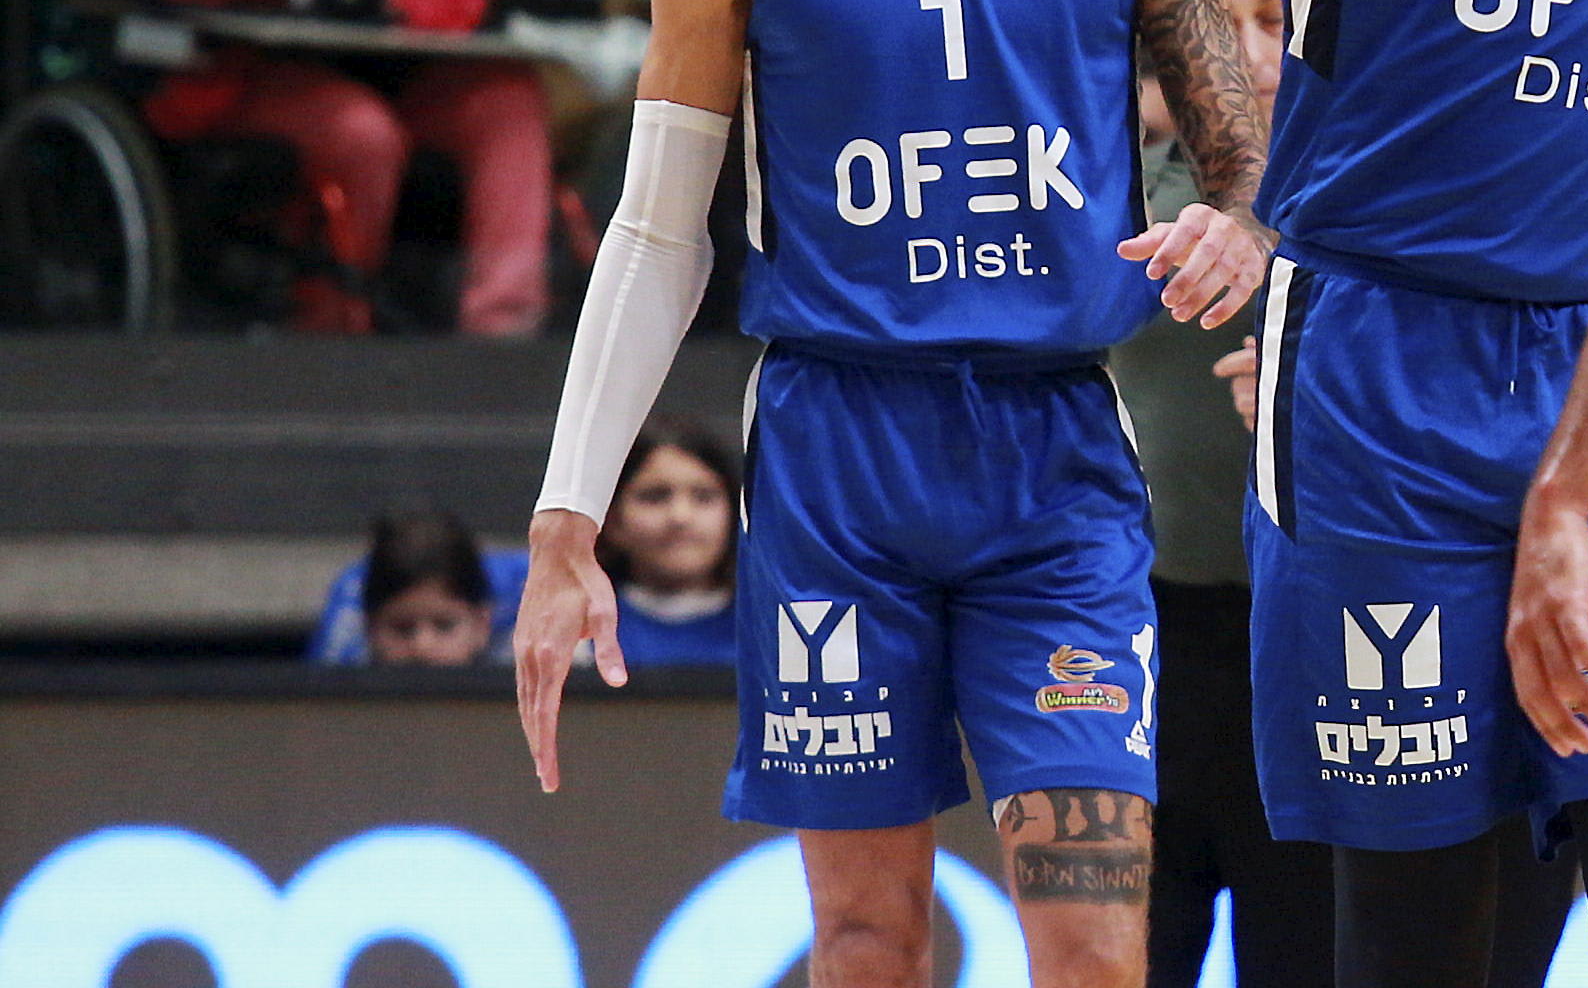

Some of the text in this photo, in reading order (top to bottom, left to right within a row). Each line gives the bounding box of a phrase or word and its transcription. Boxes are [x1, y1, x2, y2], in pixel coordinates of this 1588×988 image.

[835, 124, 1084, 226] OFEK
[908, 233, 1049, 283] Dist.
[1046, 691, 1105, 707] Winner
[763, 706, 892, 756] יובלים
[1315, 715, 1468, 766] יובלים
[1386, 763, 1469, 786] יצירתיות
